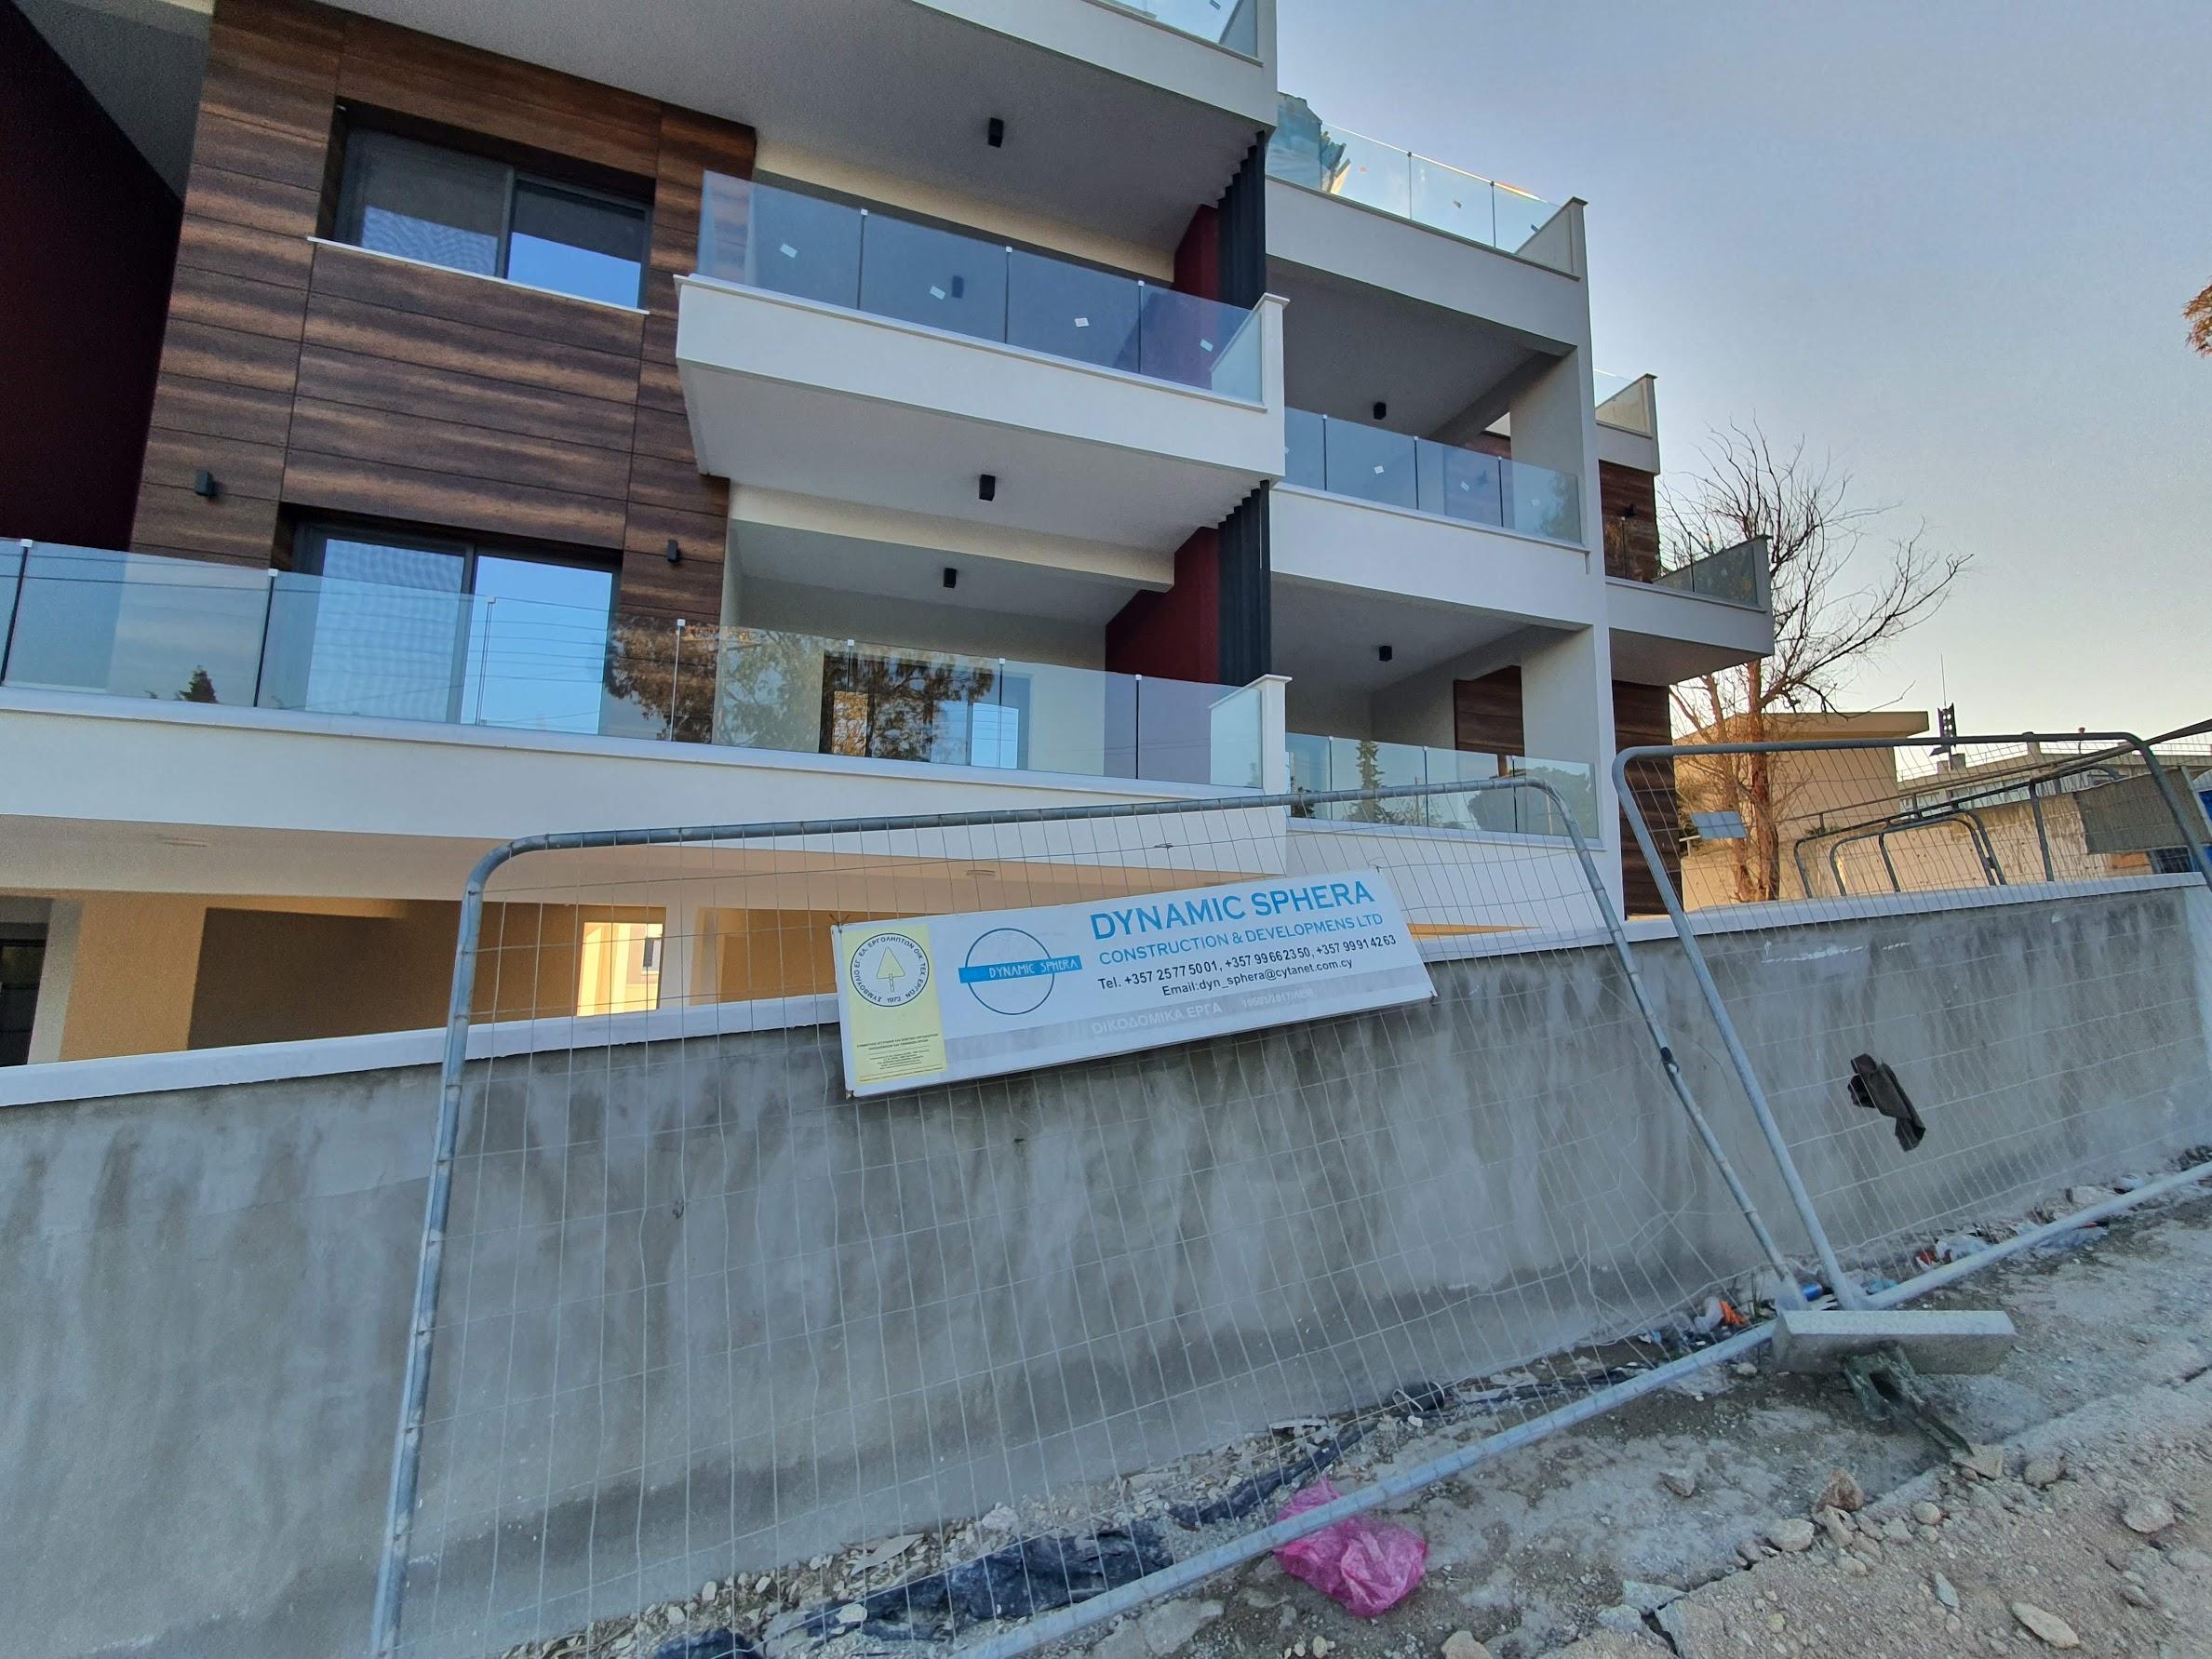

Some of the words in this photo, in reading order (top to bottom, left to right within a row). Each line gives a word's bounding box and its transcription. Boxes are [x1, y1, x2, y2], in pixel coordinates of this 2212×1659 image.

[1090, 895, 1246, 940] DYNAMIC
[1251, 881, 1375, 916] SPHERA
[1099, 933, 1229, 965] CONSTRUCTION
[1232, 932, 1243, 943] &
[1245, 916, 1356, 943] DEVELOPMENS
[1356, 913, 1384, 928] LTD
[988, 963, 1035, 979] DYNAMIC
[1040, 958, 1079, 973] SPHERA
[1097, 978, 1121, 990] Tel.
[1124, 970, 1153, 985] +357
[1226, 955, 1251, 969] +357
[1316, 943, 1340, 956] +357
[1092, 1010, 1184, 1035] ΟΙΚΟΔΟΜΙΚΑ
[1186, 1002, 1223, 1019] ΕΡΓΑ
